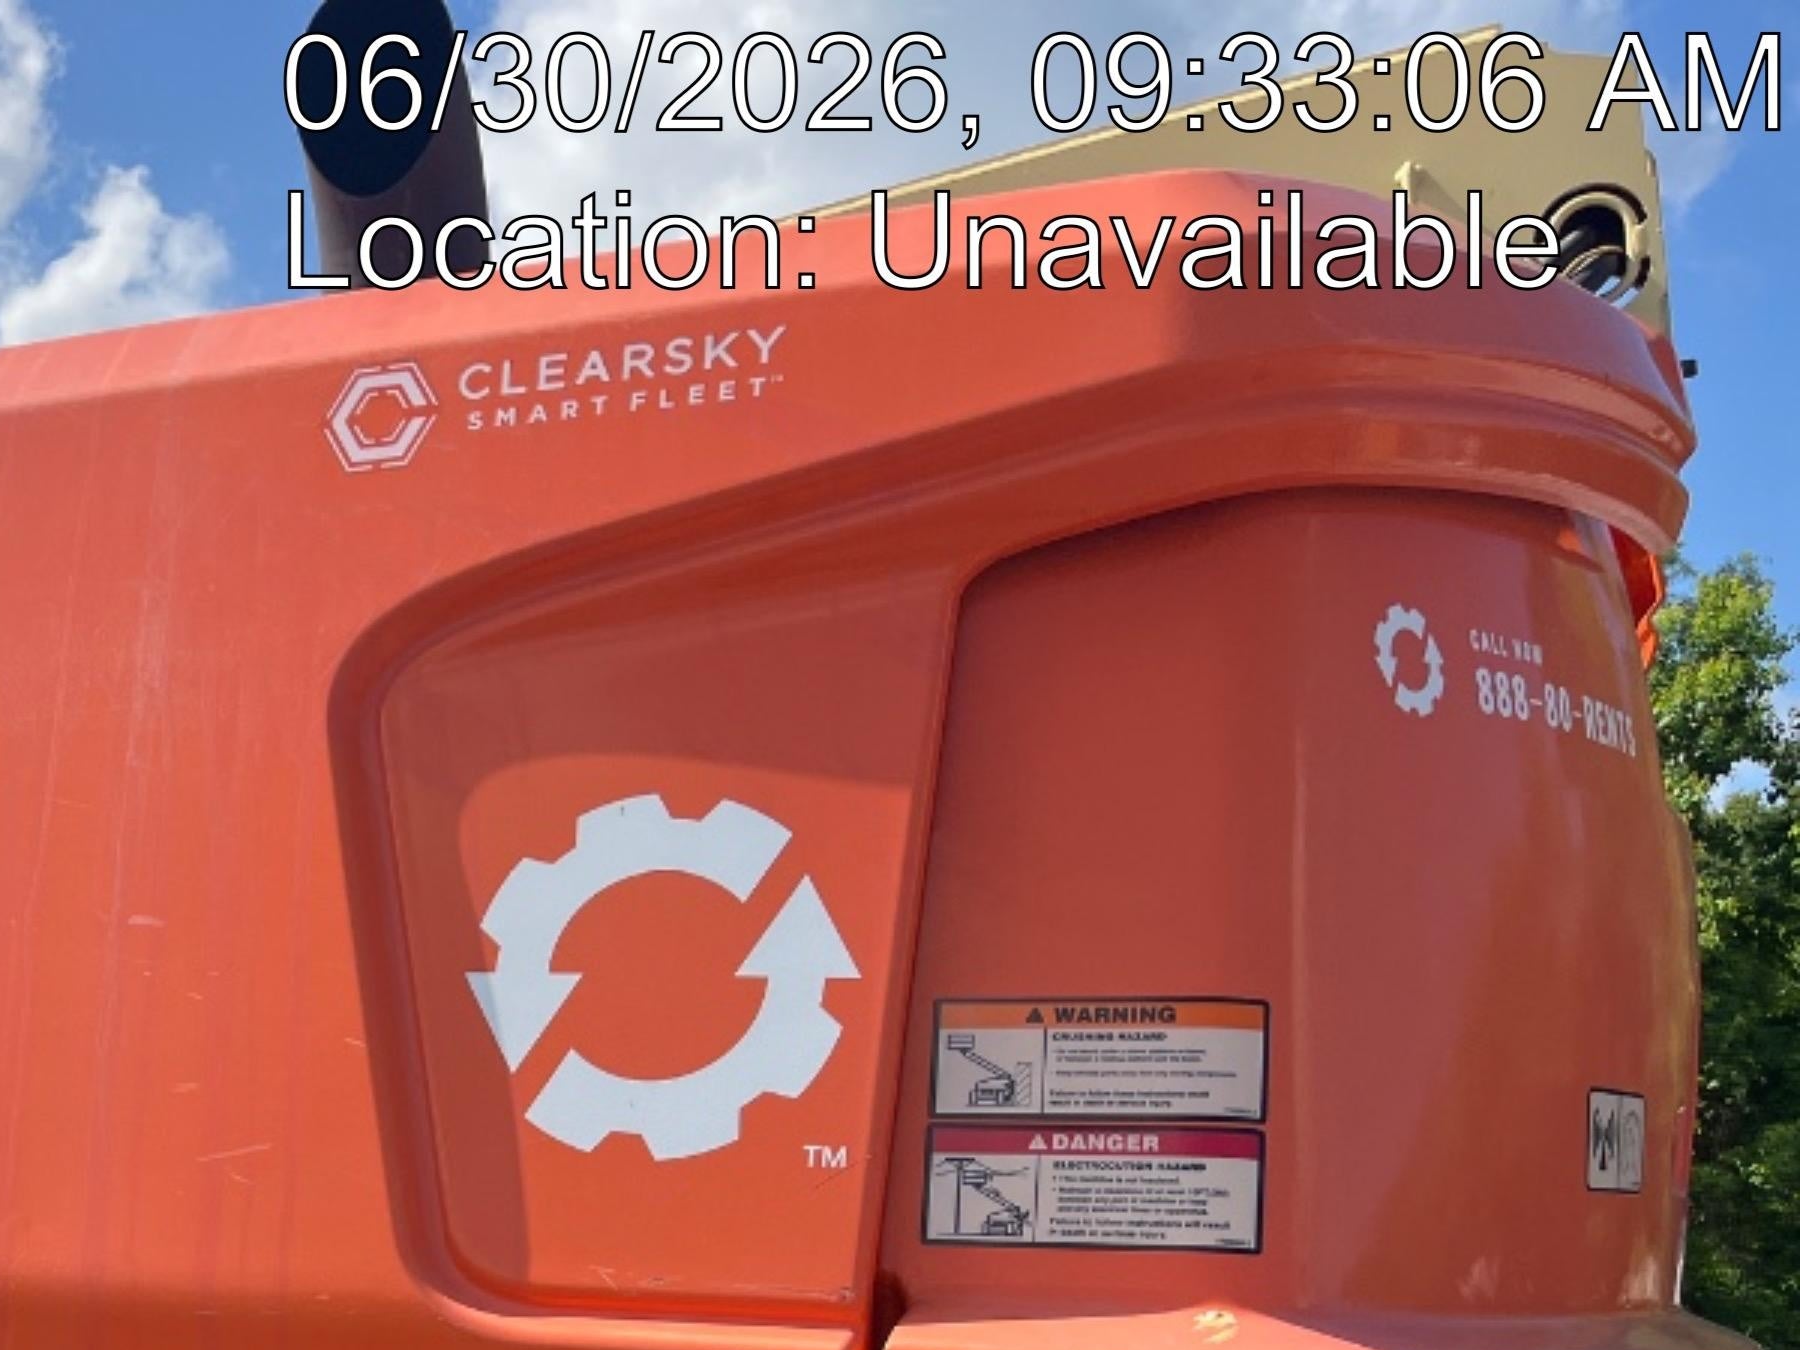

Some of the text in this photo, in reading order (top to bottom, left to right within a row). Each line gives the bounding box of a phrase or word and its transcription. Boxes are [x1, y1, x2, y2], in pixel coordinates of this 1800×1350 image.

[458, 325, 788, 400] CLEARSKY
[466, 395, 608, 431] SMART
[1469, 628, 1508, 658] CALL
[1475, 667, 1637, 758] 888-80-RENTS
[1055, 1006, 1177, 1024] WARNING
[1051, 1133, 1160, 1152] DANGER
